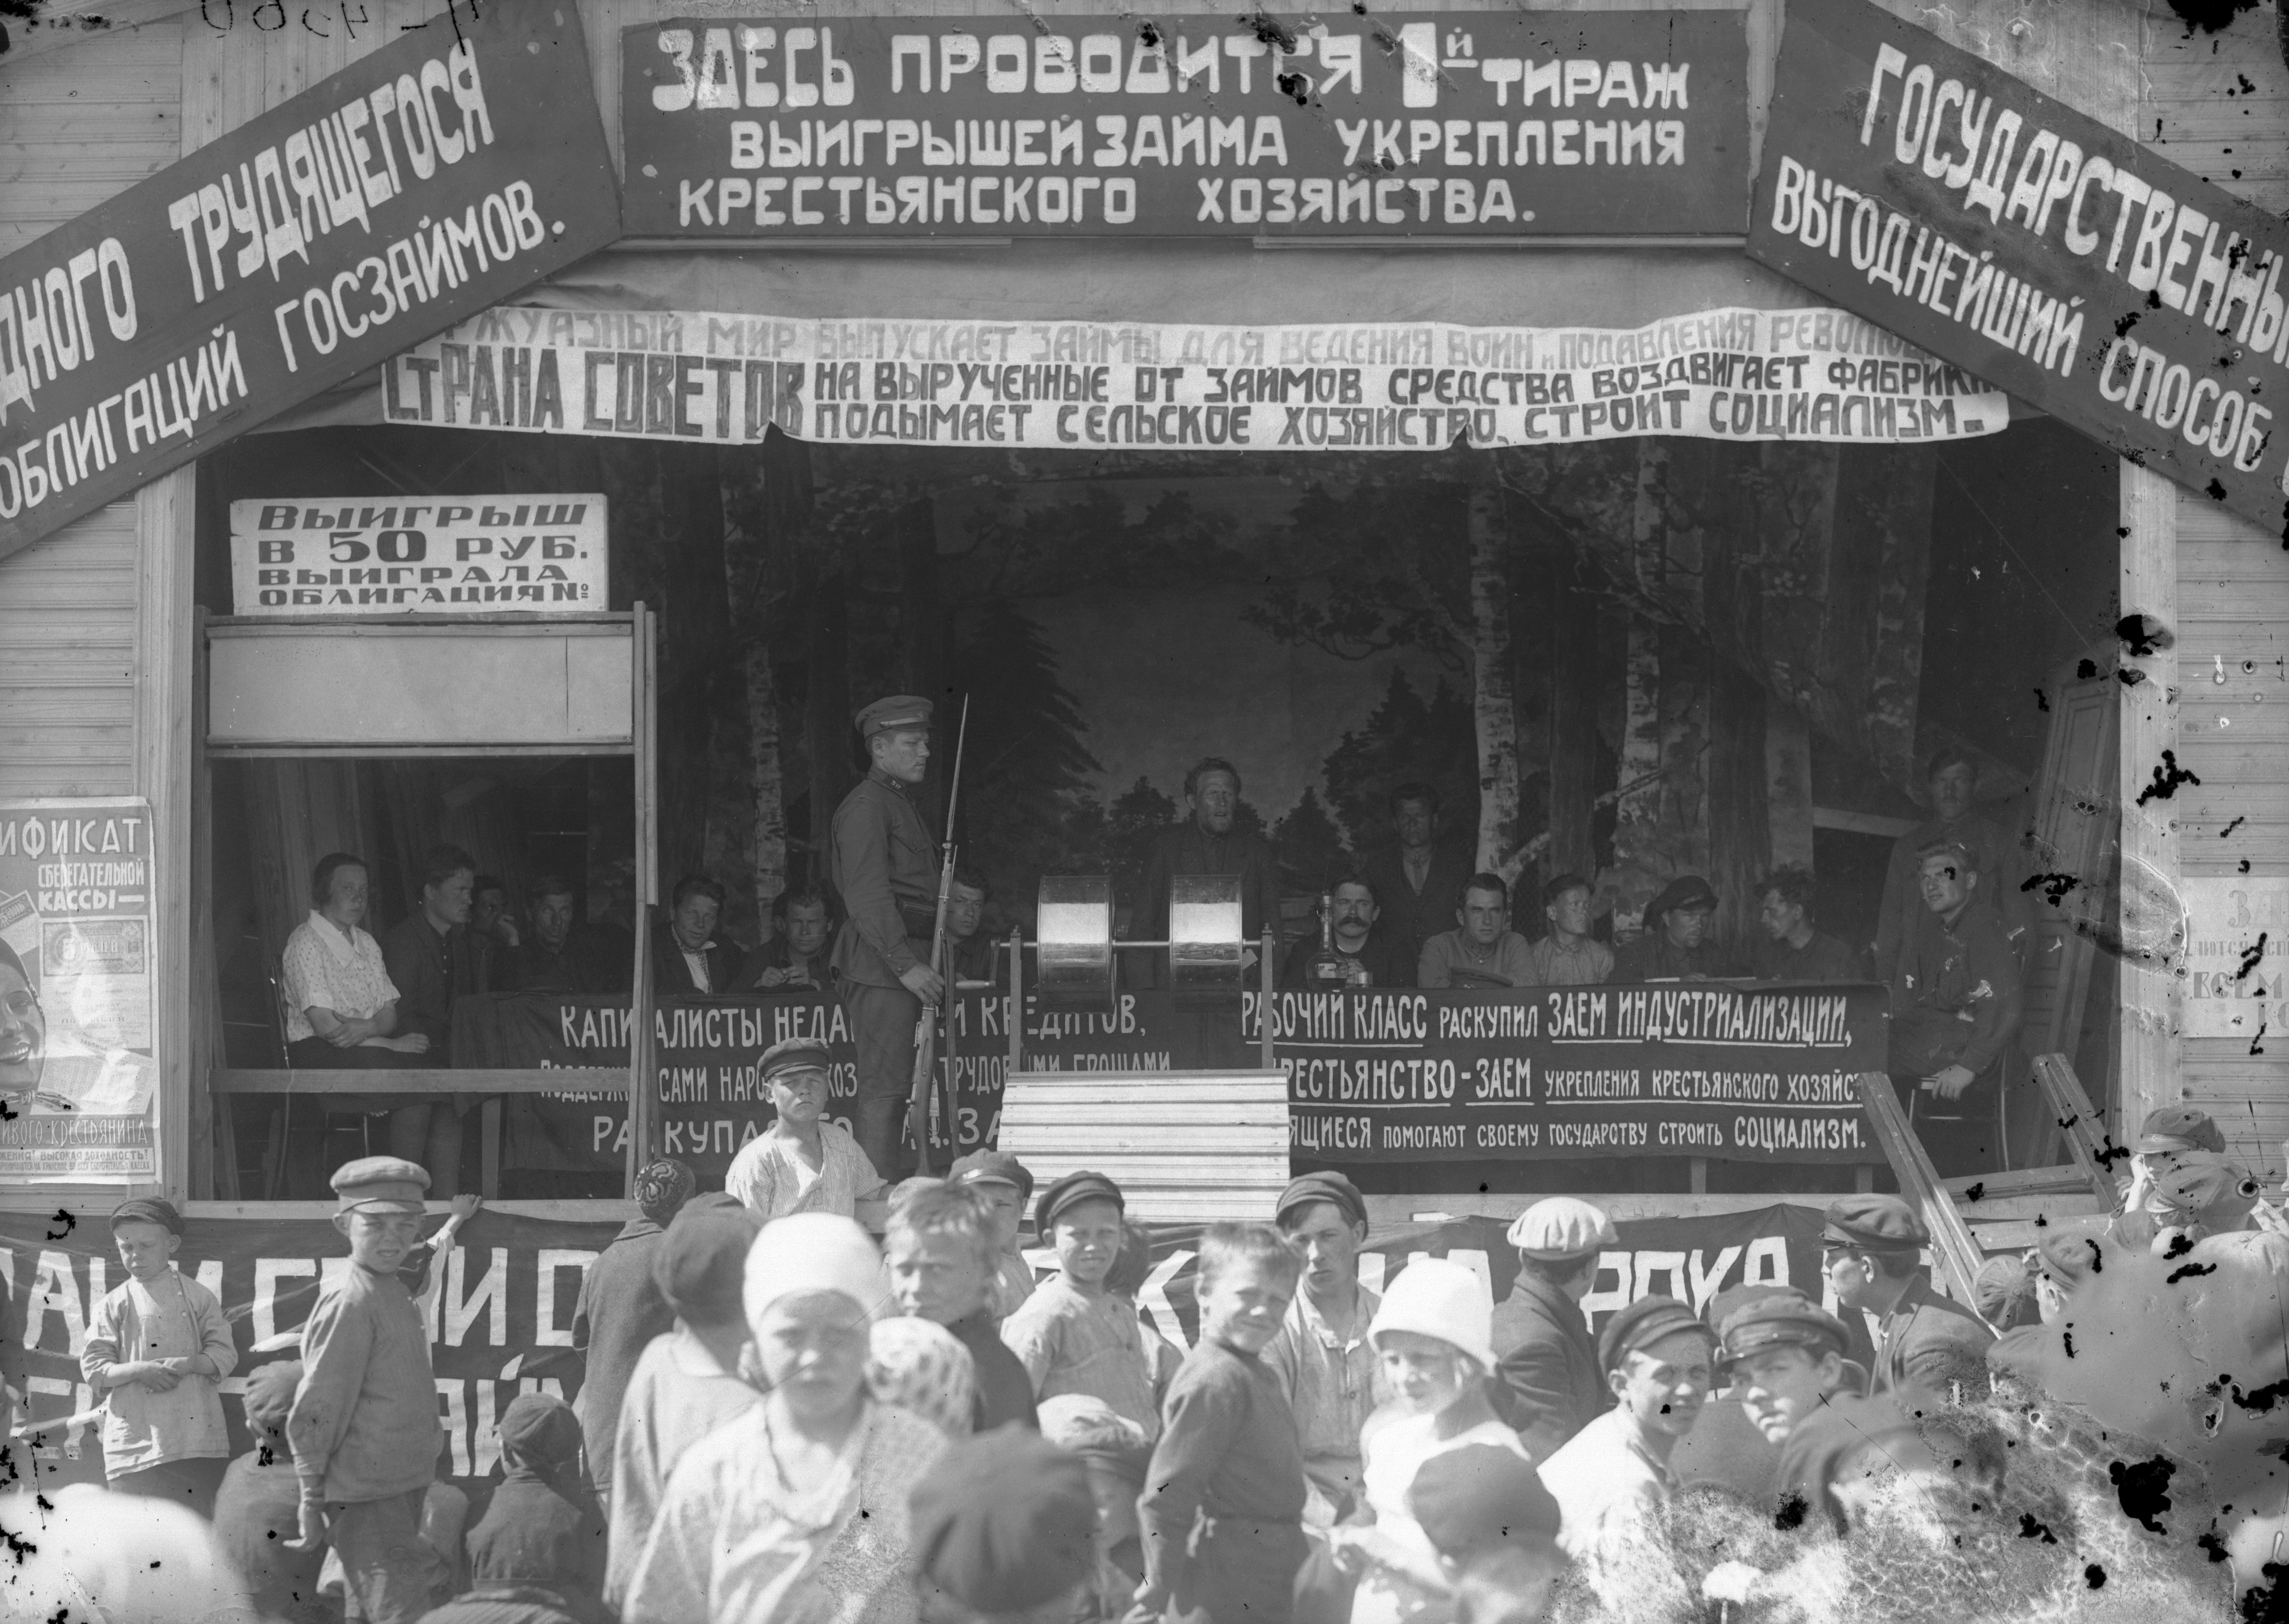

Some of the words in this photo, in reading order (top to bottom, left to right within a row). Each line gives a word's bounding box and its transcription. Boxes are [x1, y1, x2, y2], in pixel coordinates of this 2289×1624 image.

[652, 27, 854, 111] ЗДЕСЬ
[1482, 58, 1689, 109] ТИРАЖ
[730, 115, 1083, 169] ВЫИГРЫШЕЙ
[1094, 113, 1287, 167] ЗАЙМА
[1334, 119, 1686, 167] УКРЕПЛЕНИЯ
[168, 38, 494, 303] ТРУДЯЩЕГОСЯ
[680, 176, 1136, 227] КРЕСТЬЯНСКОГО
[1198, 173, 1536, 223] ХОЗЯЙСТВА.
[1861, 42, 2289, 369] ГОСУДАРСТВЕННЫ
[707, 317, 796, 358] МИР
[815, 323, 1018, 361] ВЫПУСКАЕТ
[1031, 325, 1161, 364] ЗАЙМЫ
[1176, 330, 1265, 367] ДЛЯ
[1279, 328, 1433, 365] ВЕДЕНИЯ
[1559, 313, 1756, 370] ПОДАВЛЕНИЯ
[1770, 312, 1925, 359] РЕВОЛЮ
[1772, 156, 2084, 377] ВЫГОДНЕЙШИЙ
[2099, 335, 2273, 472] СПОСОБ
[0, 323, 248, 519] ОБЛИГАЦИЙ
[275, 180, 565, 372] ГОСЗАЙМОВ.
[382, 343, 564, 429] СТРАНА
[583, 351, 805, 440] СОВЕТОВ
[815, 362, 860, 400] НА
[874, 362, 1109, 402] ВЫРУЧЕННЫЕ
[1135, 366, 1184, 403] ОТ
[1204, 366, 1362, 403] ЗАЙМОВ
[1388, 368, 1575, 406] СРЕДСТВА
[1593, 352, 1810, 398] ВОЗДВИГАЕТ
[815, 403, 1031, 441] ПОДЫМАЕТ
[1057, 404, 1251, 445] СЕЛЬСКОЕ
[1525, 390, 1690, 438] СТРОИТ
[258, 540, 294, 564] В
[329, 530, 427, 562] 50
[456, 535, 588, 561] РУБ.
[258, 565, 568, 586] ВЫИГРАЛА
[259, 586, 544, 606] ОБЛИГАЦИЯ
[561, 1006, 763, 1048] КАПИАЛИСТЫ
[1354, 995, 1427, 1039] КЛАСС
[1440, 1005, 1537, 1039] РАСКУПИЛ
[1548, 992, 1607, 1037] ЗАЕМ
[1618, 991, 1852, 1047] ИНДУСТРИАЛИЗАЦИИ,
[1545, 1069, 1640, 1097] УКРЕПЛЕНИЯ
[1653, 1069, 1779, 1101] КРЕСТЬЯНСКОГО
[40, 1150, 83, 1161] ВЫСОКАЯ
[1289, 1115, 1371, 1150] ЯЩИЕСЯ
[1384, 1124, 1466, 1149] ПОМОГАЮТ
[1477, 1124, 1539, 1146] СВОЕМУ
[1549, 1123, 1647, 1147] ГОСУДАРСТВУ
[1659, 1122, 1723, 1146] СТРОИТЬ
[1735, 1116, 1866, 1153] СОЦИАЛИЗМ.
